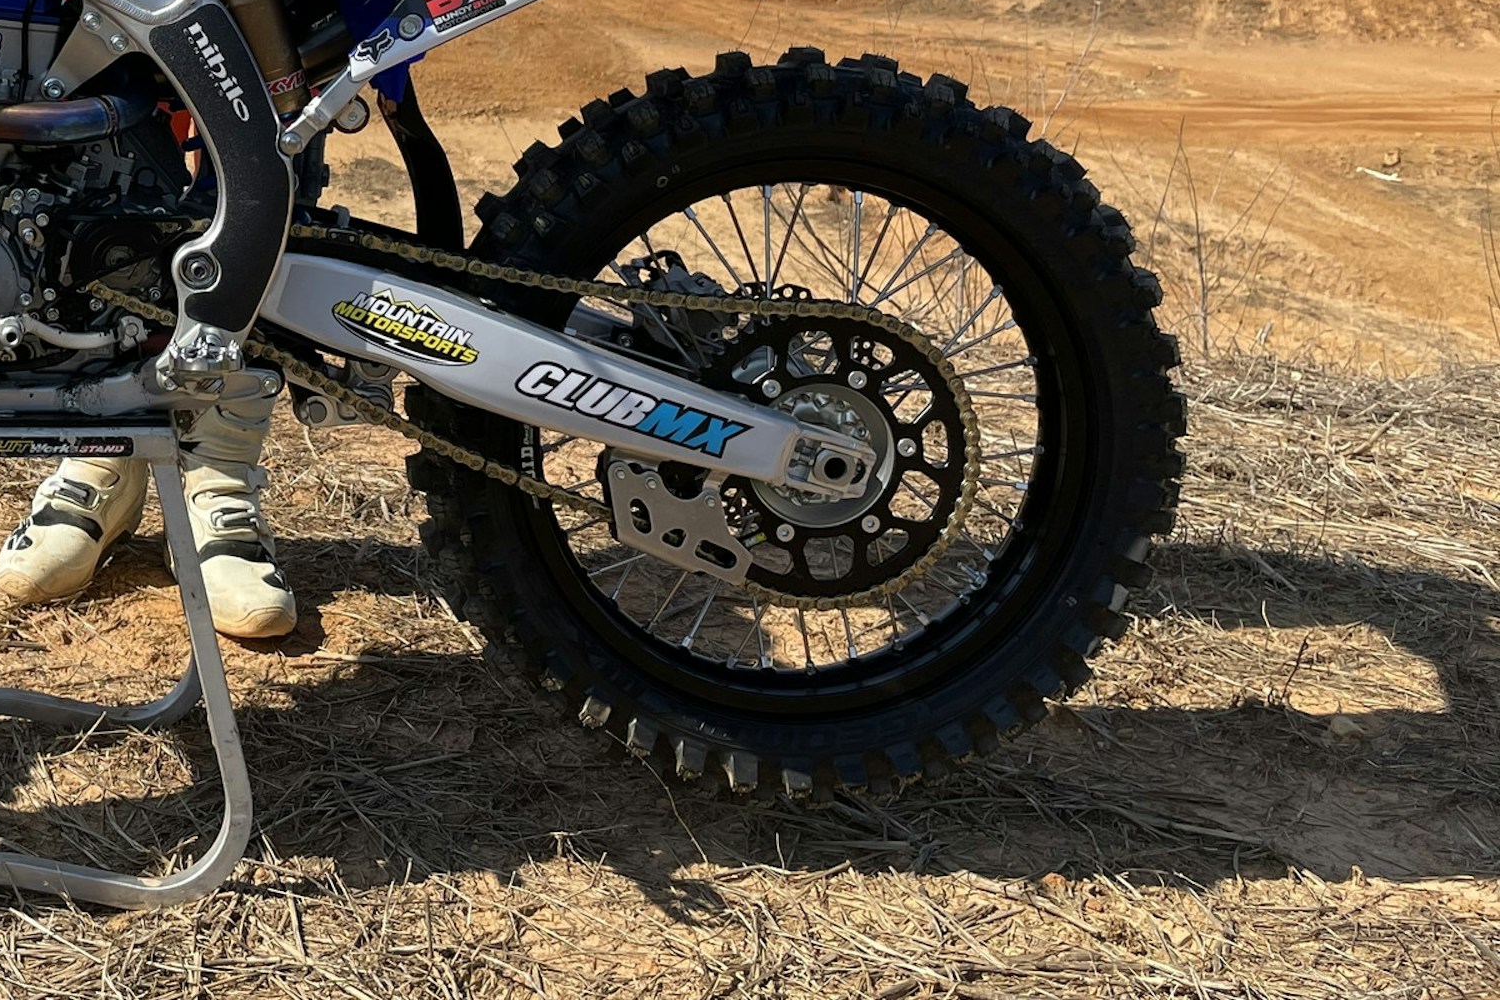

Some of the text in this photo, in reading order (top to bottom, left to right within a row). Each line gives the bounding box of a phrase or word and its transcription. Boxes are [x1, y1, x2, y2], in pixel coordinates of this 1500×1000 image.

[188, 21, 250, 122] nihilo
[334, 301, 479, 363] MOTORSPORTS
[352, 292, 473, 345] MOUNTAIN
[516, 362, 753, 457] CLUBMX
[79, 445, 125, 455] STAND
